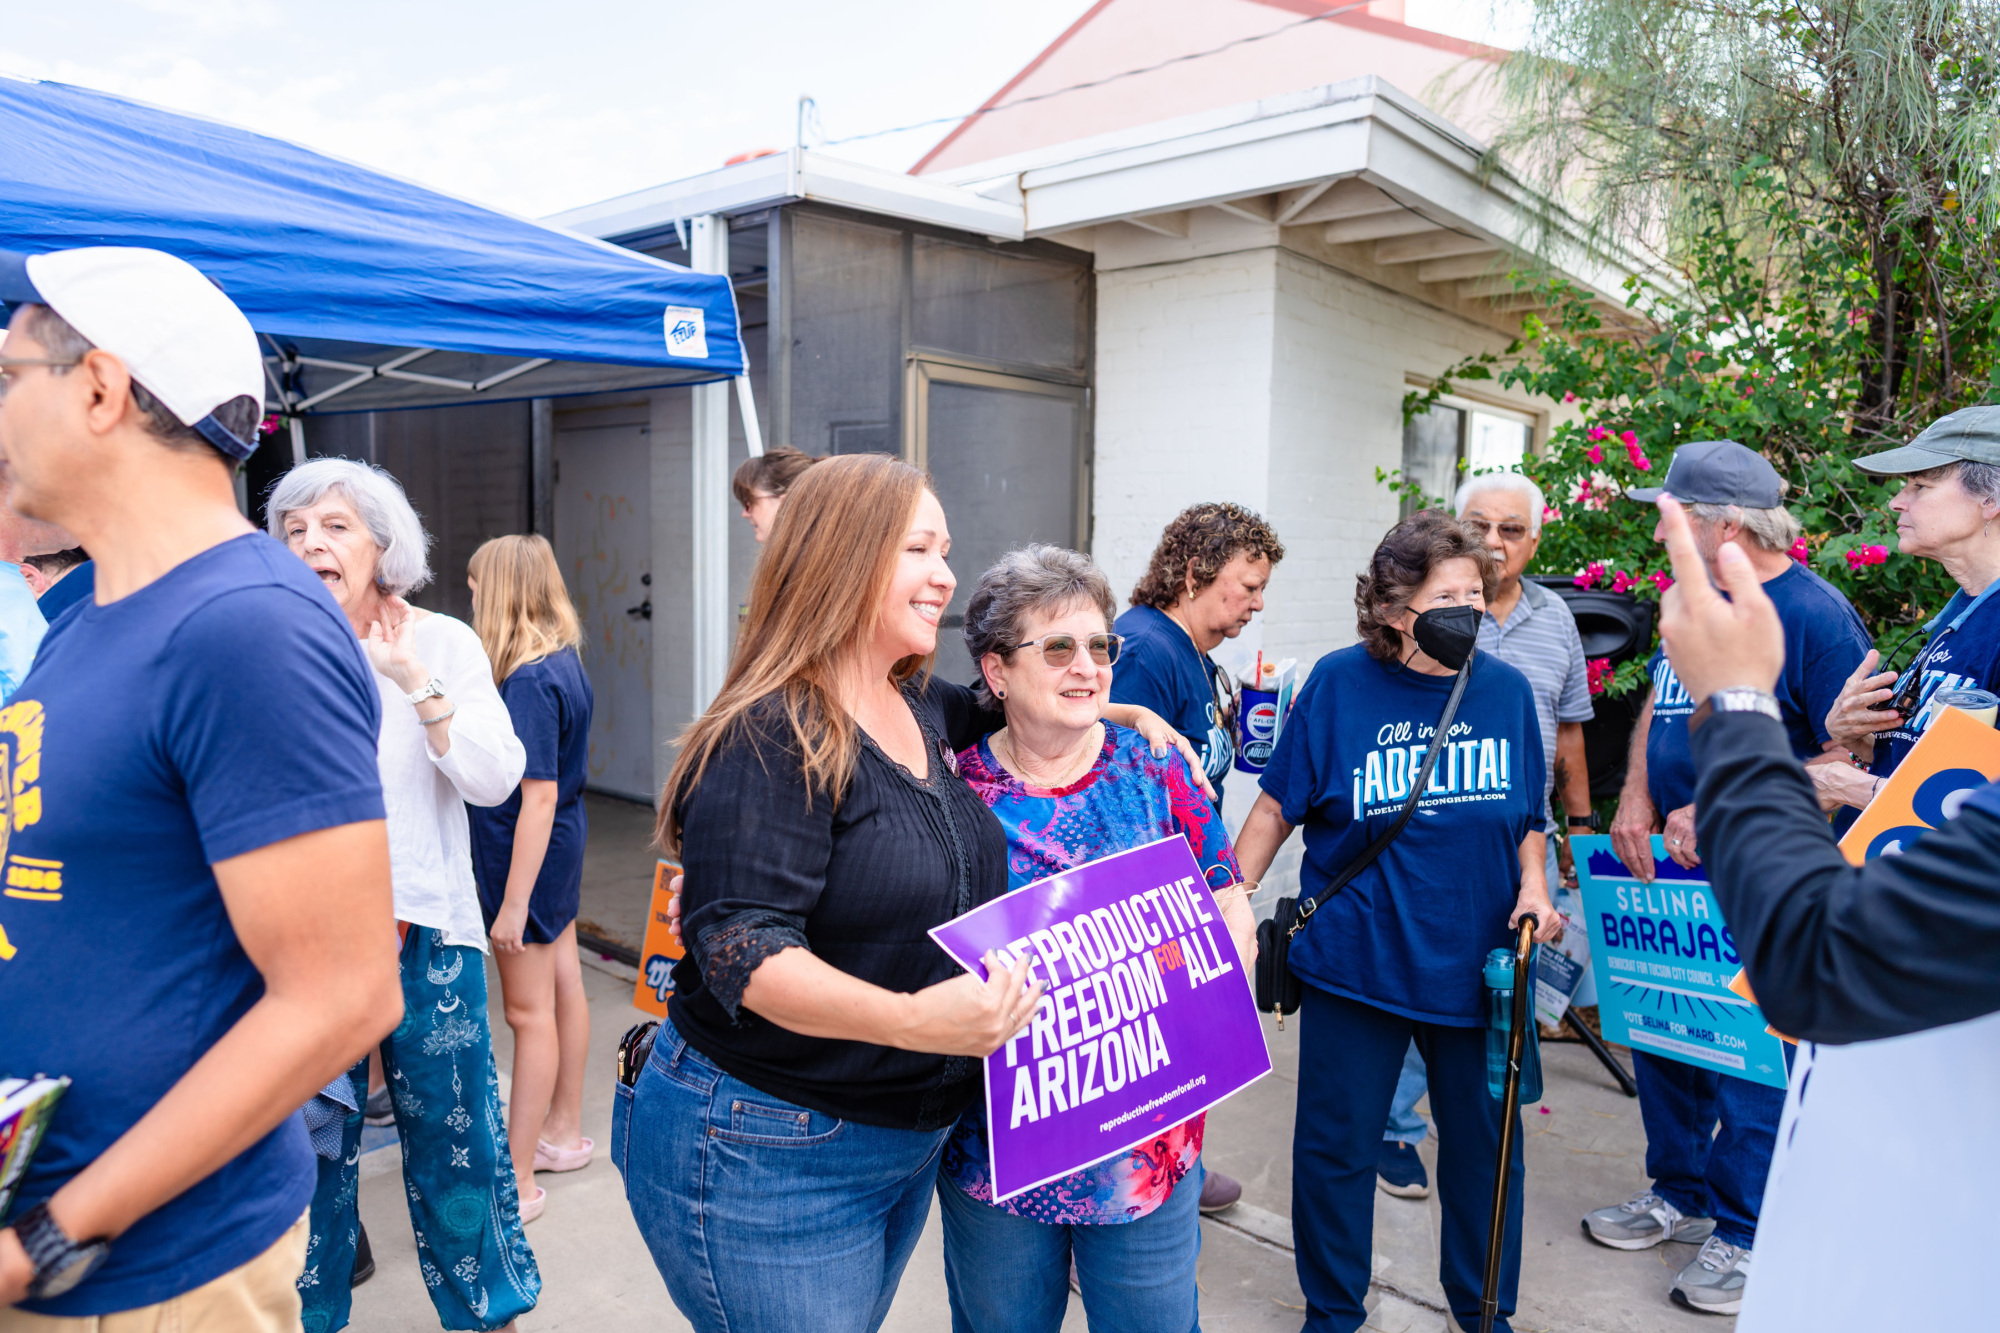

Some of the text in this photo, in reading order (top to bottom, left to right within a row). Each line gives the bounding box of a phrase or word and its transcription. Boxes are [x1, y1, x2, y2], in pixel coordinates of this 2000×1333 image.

[1377, 721, 1413, 746] All
[1418, 722, 1437, 739] in
[1366, 793, 1507, 817] ADELITRCONGRESS.COM
[1616, 885, 1709, 919] SELINA
[1152, 939, 1187, 976] FOR
[1179, 925, 1234, 990] ALL
[1601, 911, 1741, 965] BARAJAS
[1607, 955, 1637, 973] DEMOCRAT
[1636, 960, 1649, 975] FOR
[1647, 962, 1673, 979] TUCSON
[1671, 966, 1687, 981] CITY
[1686, 968, 1716, 987] COUNCIL
[1623, 1010, 1748, 1051] VOTESELINAFORWARD5.COM
[1010, 1012, 1171, 1130] ARIZONA
[1099, 1074, 1207, 1133] reproductivefreedomforall.org
